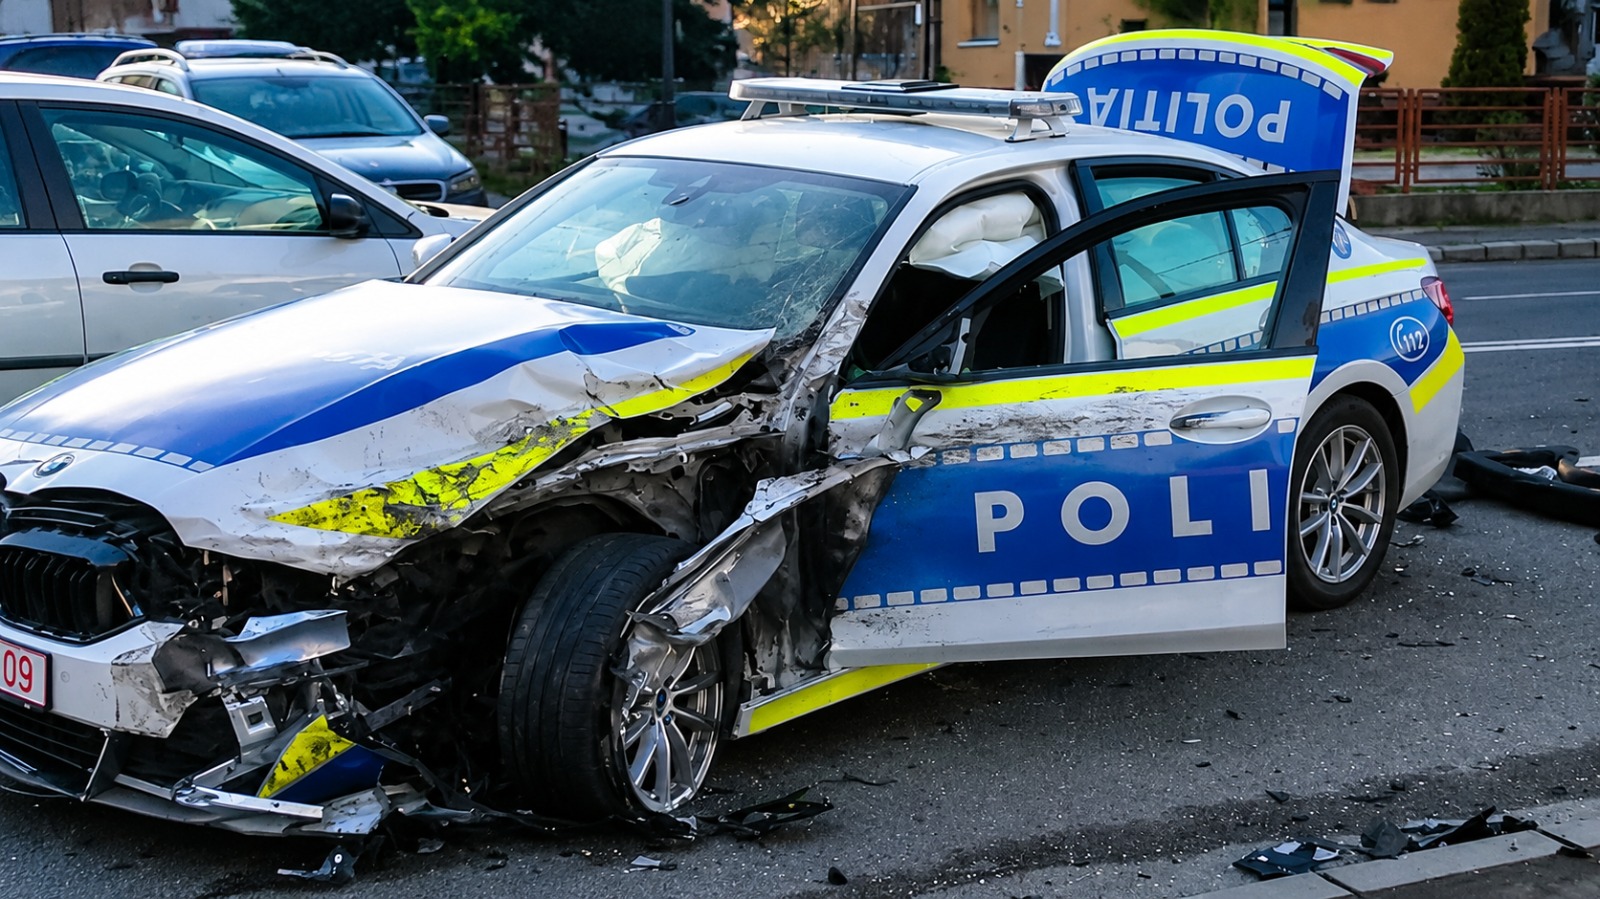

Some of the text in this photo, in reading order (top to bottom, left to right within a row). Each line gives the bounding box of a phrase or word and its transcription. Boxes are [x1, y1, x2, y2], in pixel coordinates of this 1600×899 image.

[1403, 330, 1424, 353] 112
[974, 468, 1271, 553] POLI
[3, 649, 33, 694] 09
